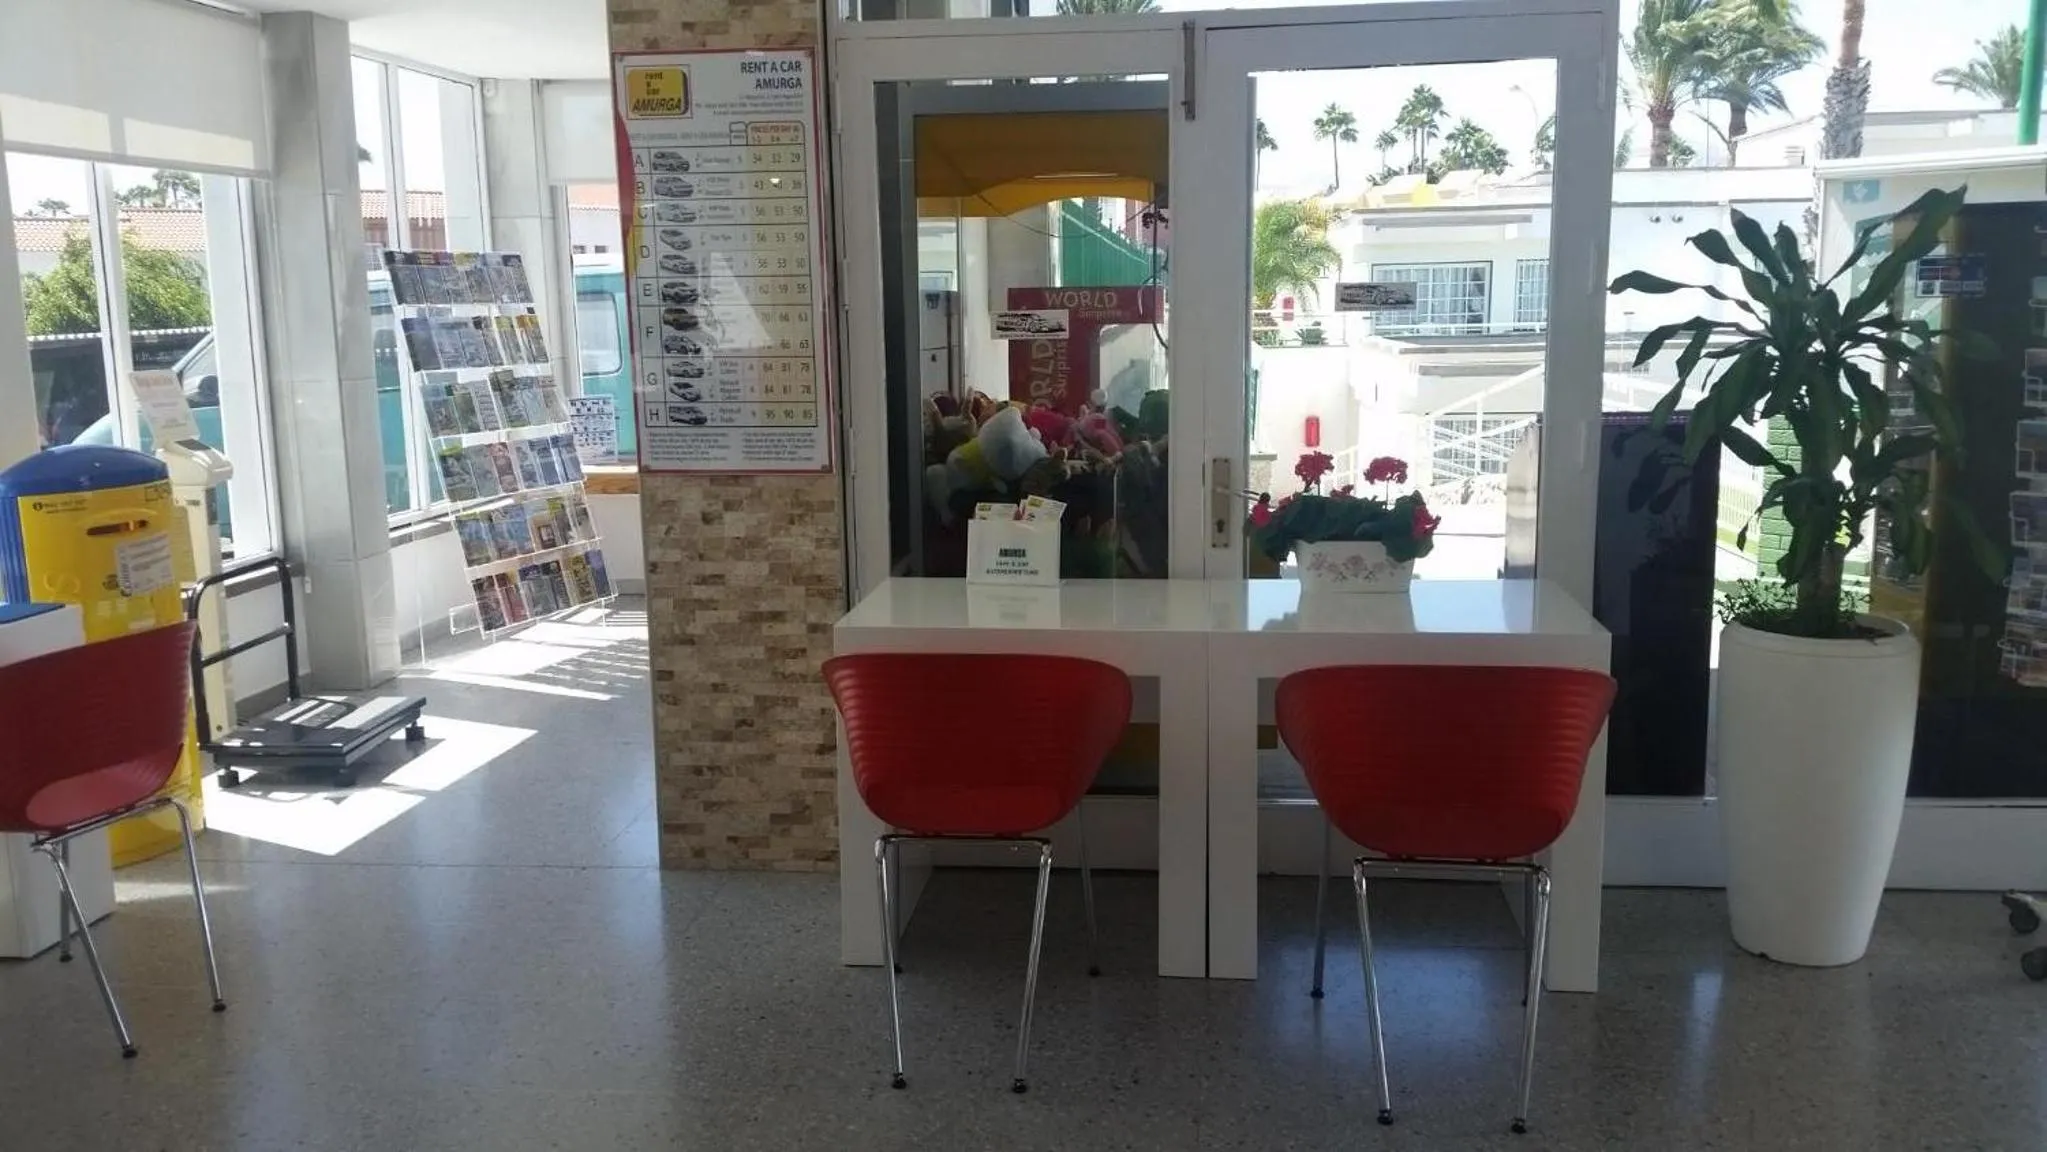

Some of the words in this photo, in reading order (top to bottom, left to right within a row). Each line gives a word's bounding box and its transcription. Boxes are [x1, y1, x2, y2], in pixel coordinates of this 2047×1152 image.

[741, 61, 768, 73] RENT
[770, 61, 778, 73] A
[780, 60, 802, 72] CAR
[755, 77, 803, 90] AMURGA
[632, 98, 682, 112] AMURGA
[635, 155, 644, 168] A
[791, 152, 801, 163] 29
[636, 181, 645, 194] B
[637, 205, 648, 220] C
[640, 245, 650, 259] D
[643, 284, 653, 297] E
[1045, 290, 1118, 308] WORLD
[646, 326, 655, 339] F
[647, 372, 657, 386] G
[649, 408, 659, 421] H
